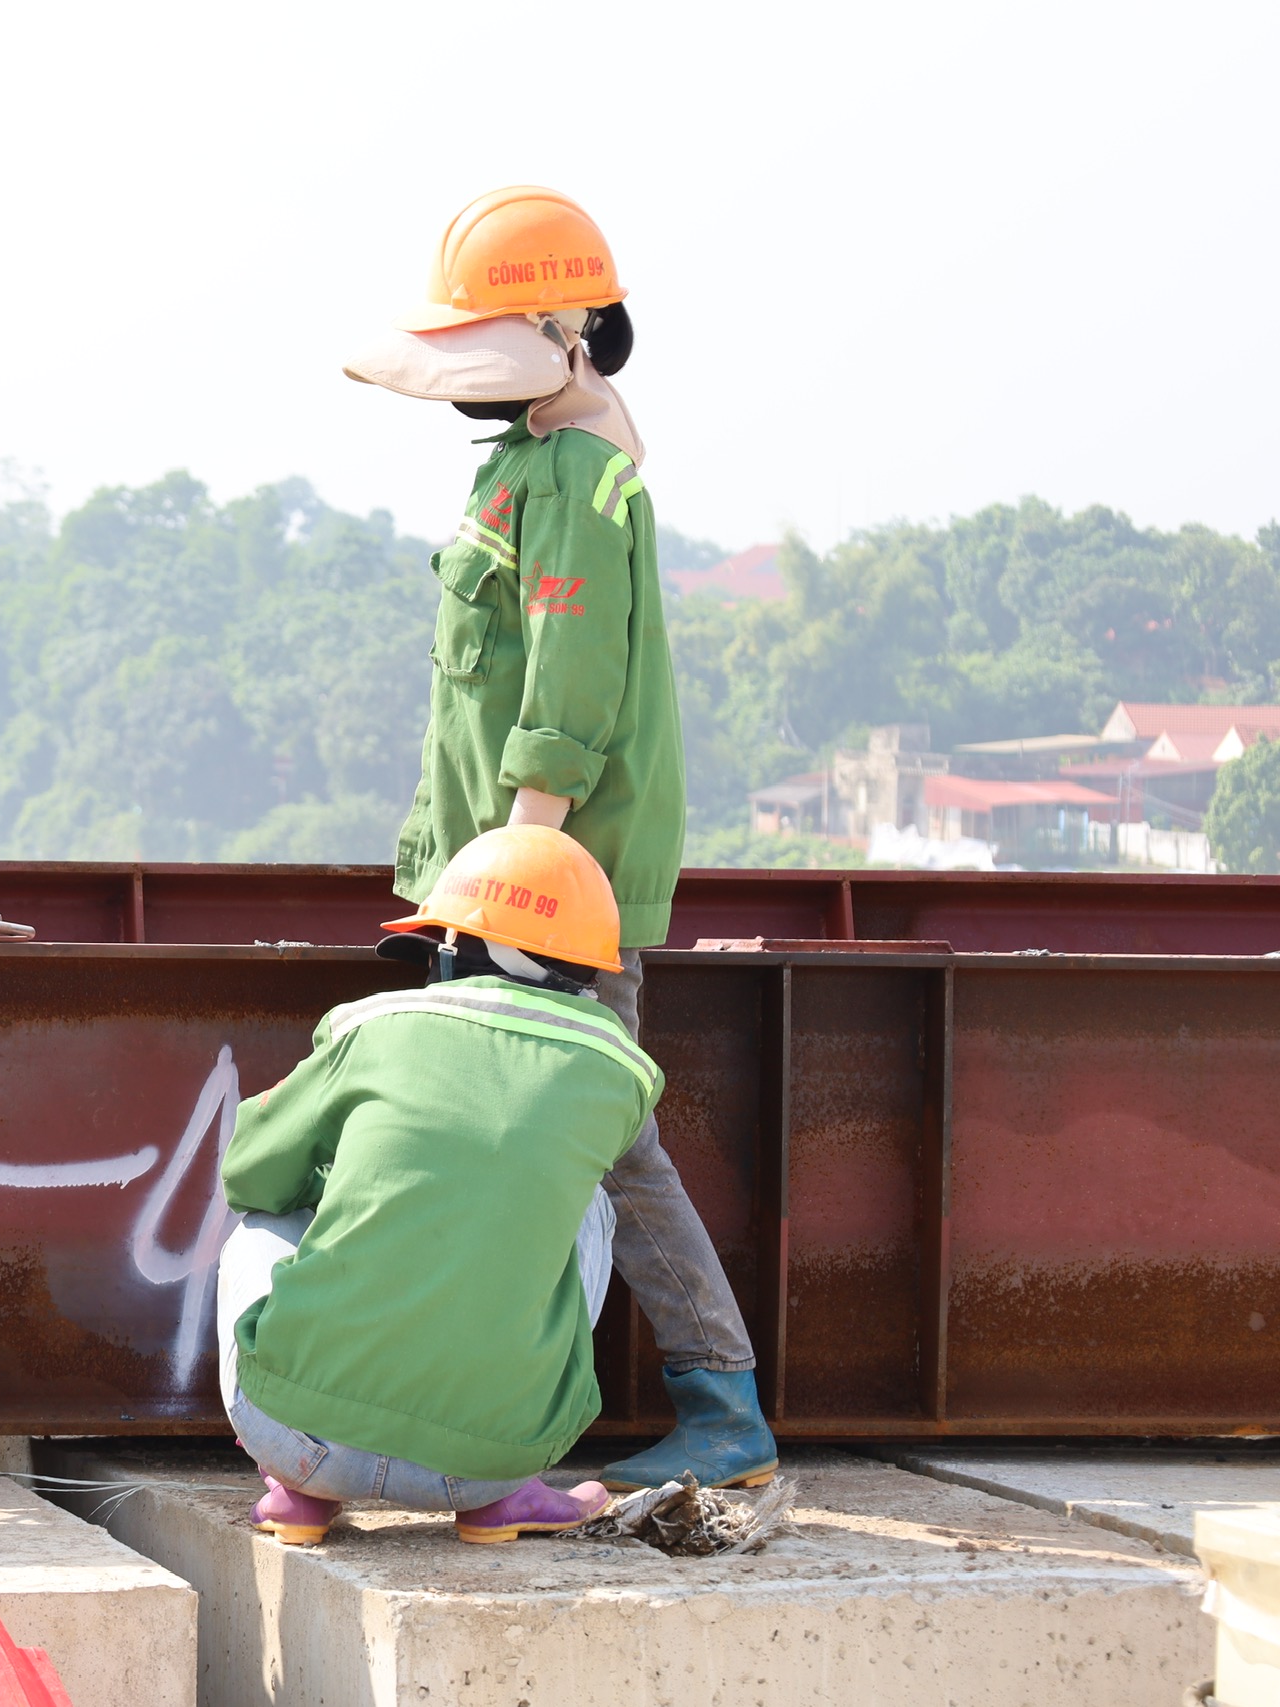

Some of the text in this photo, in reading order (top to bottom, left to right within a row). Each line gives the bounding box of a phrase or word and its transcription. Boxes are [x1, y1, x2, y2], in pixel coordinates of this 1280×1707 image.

[488, 256, 602, 287] CÔNG TY XD 99
[484, 879, 506, 902] TY
[505, 884, 532, 909] XD
[534, 894, 559, 918] 99
